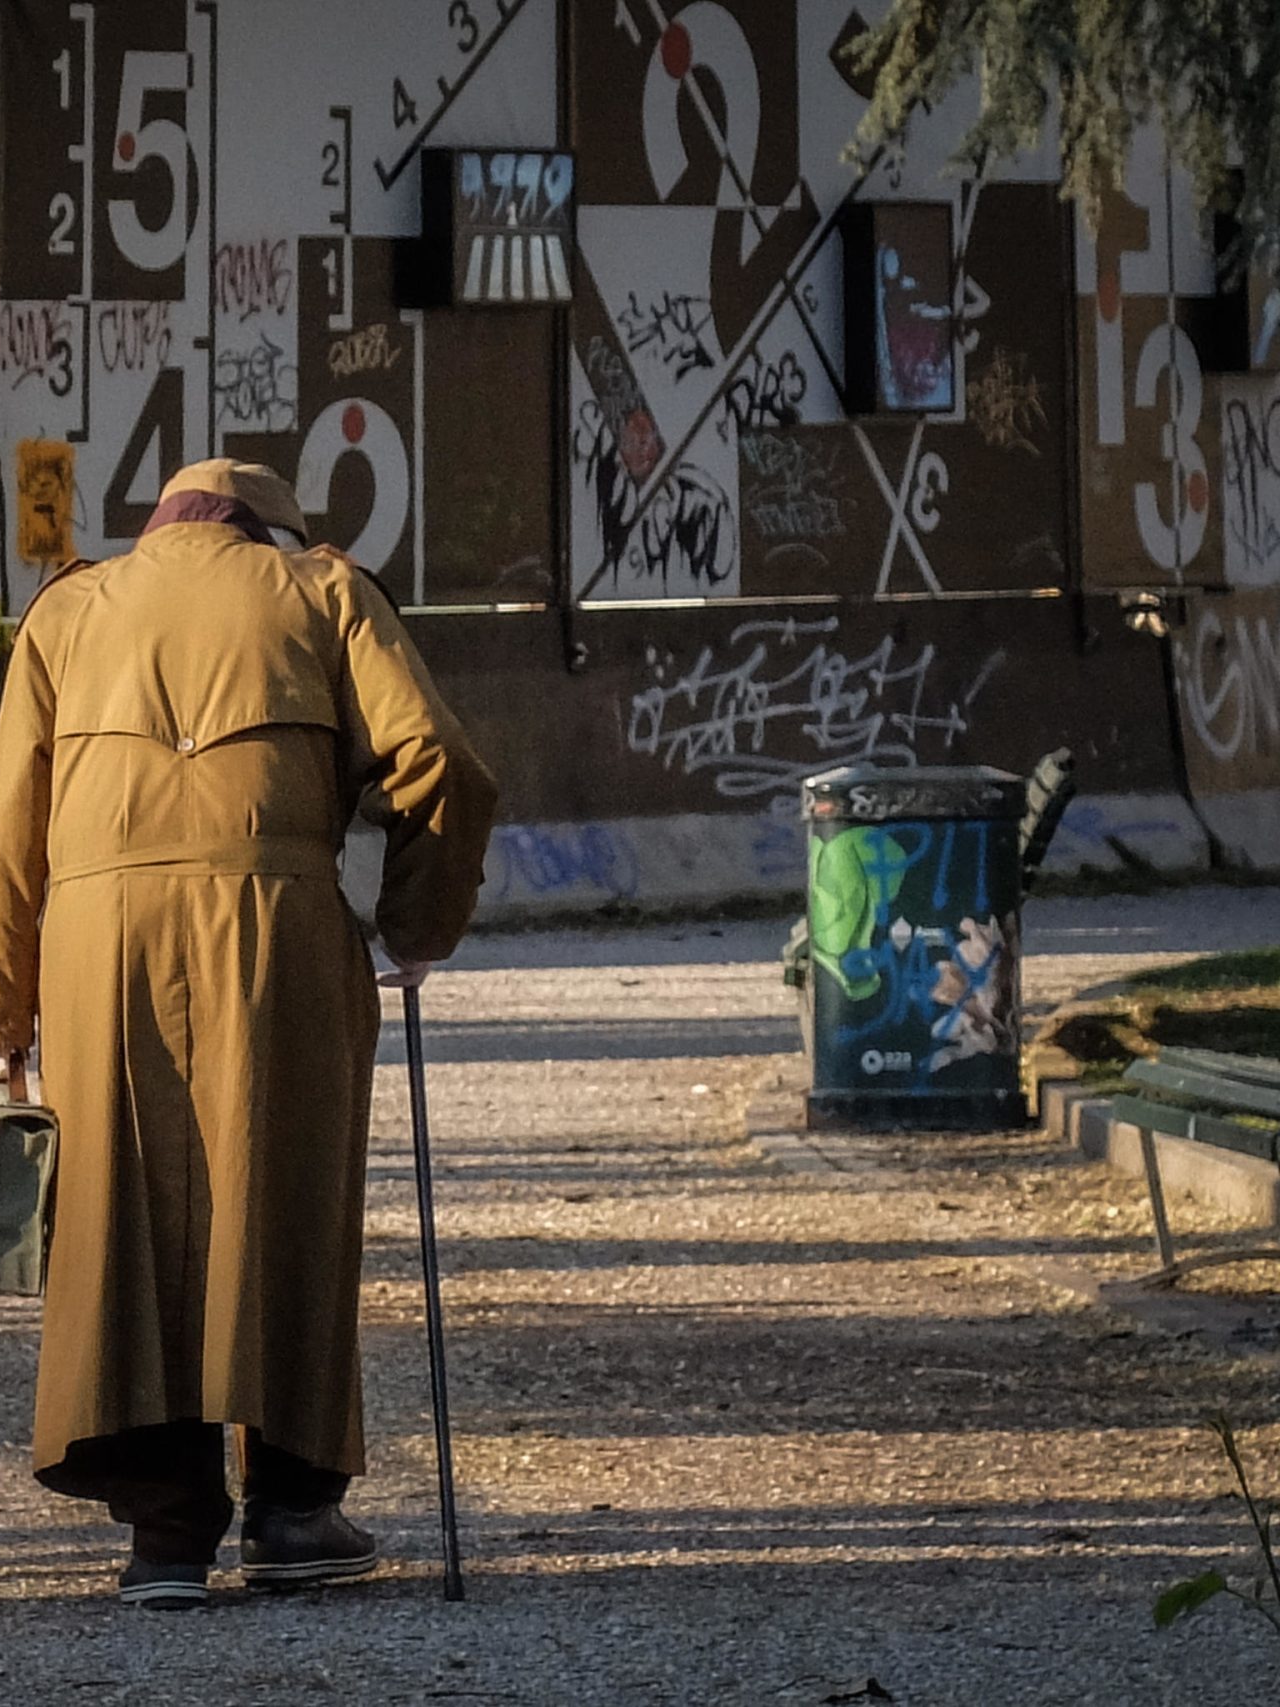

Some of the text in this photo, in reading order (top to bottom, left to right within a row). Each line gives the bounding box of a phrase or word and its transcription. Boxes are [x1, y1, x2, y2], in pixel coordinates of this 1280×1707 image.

[53, 49, 70, 110] 1
[391, 76, 418, 129] 4
[107, 50, 200, 272] 5
[322, 142, 340, 187] 2
[48, 192, 75, 255] 2
[322, 250, 337, 297] 1
[48, 339, 74, 397] 3
[102, 366, 185, 539] 4
